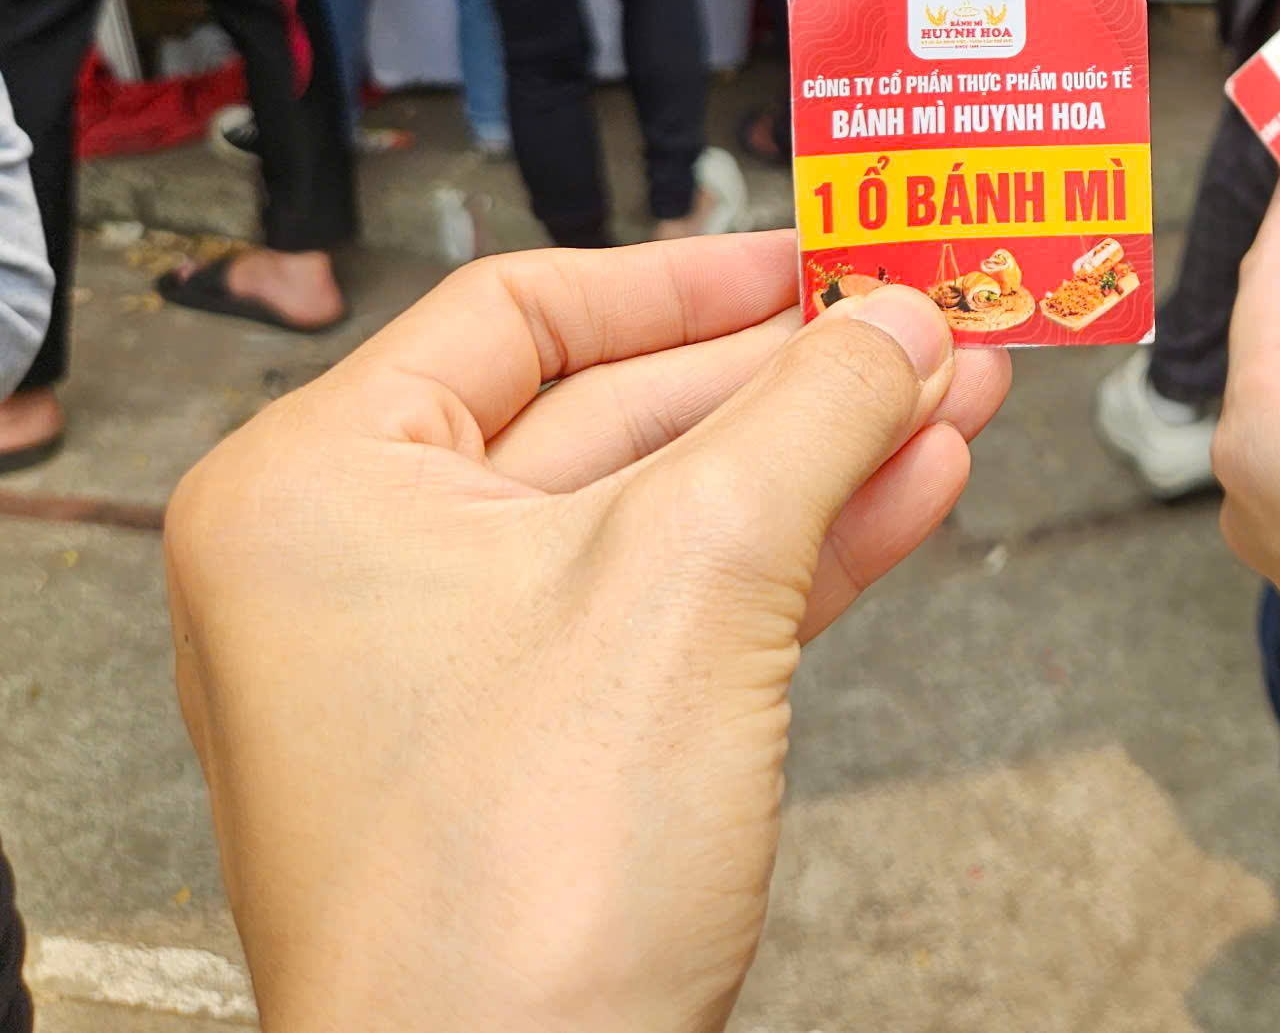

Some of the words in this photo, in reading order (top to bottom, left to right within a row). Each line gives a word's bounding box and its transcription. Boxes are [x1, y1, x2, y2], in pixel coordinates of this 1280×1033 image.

[920, 28, 976, 39] HUYNH
[980, 27, 1013, 38] HOA
[803, 75, 850, 98] CÔNG
[854, 77, 874, 96] TY
[878, 69, 903, 95] CỔ
[957, 72, 1001, 96] THỰC
[1006, 65, 1057, 92] PHẨM
[1062, 65, 1108, 92] QUỐC
[1112, 64, 1133, 89] TẾ
[832, 103, 904, 139] BÁNH
[912, 100, 946, 135] MÌ
[954, 103, 1044, 133] HUYNH
[1052, 102, 1106, 130] HOA
[814, 182, 833, 234] 1
[858, 155, 890, 230] Ổ
[906, 162, 1045, 227] BÁNH
[1064, 158, 1126, 222] MÌ
